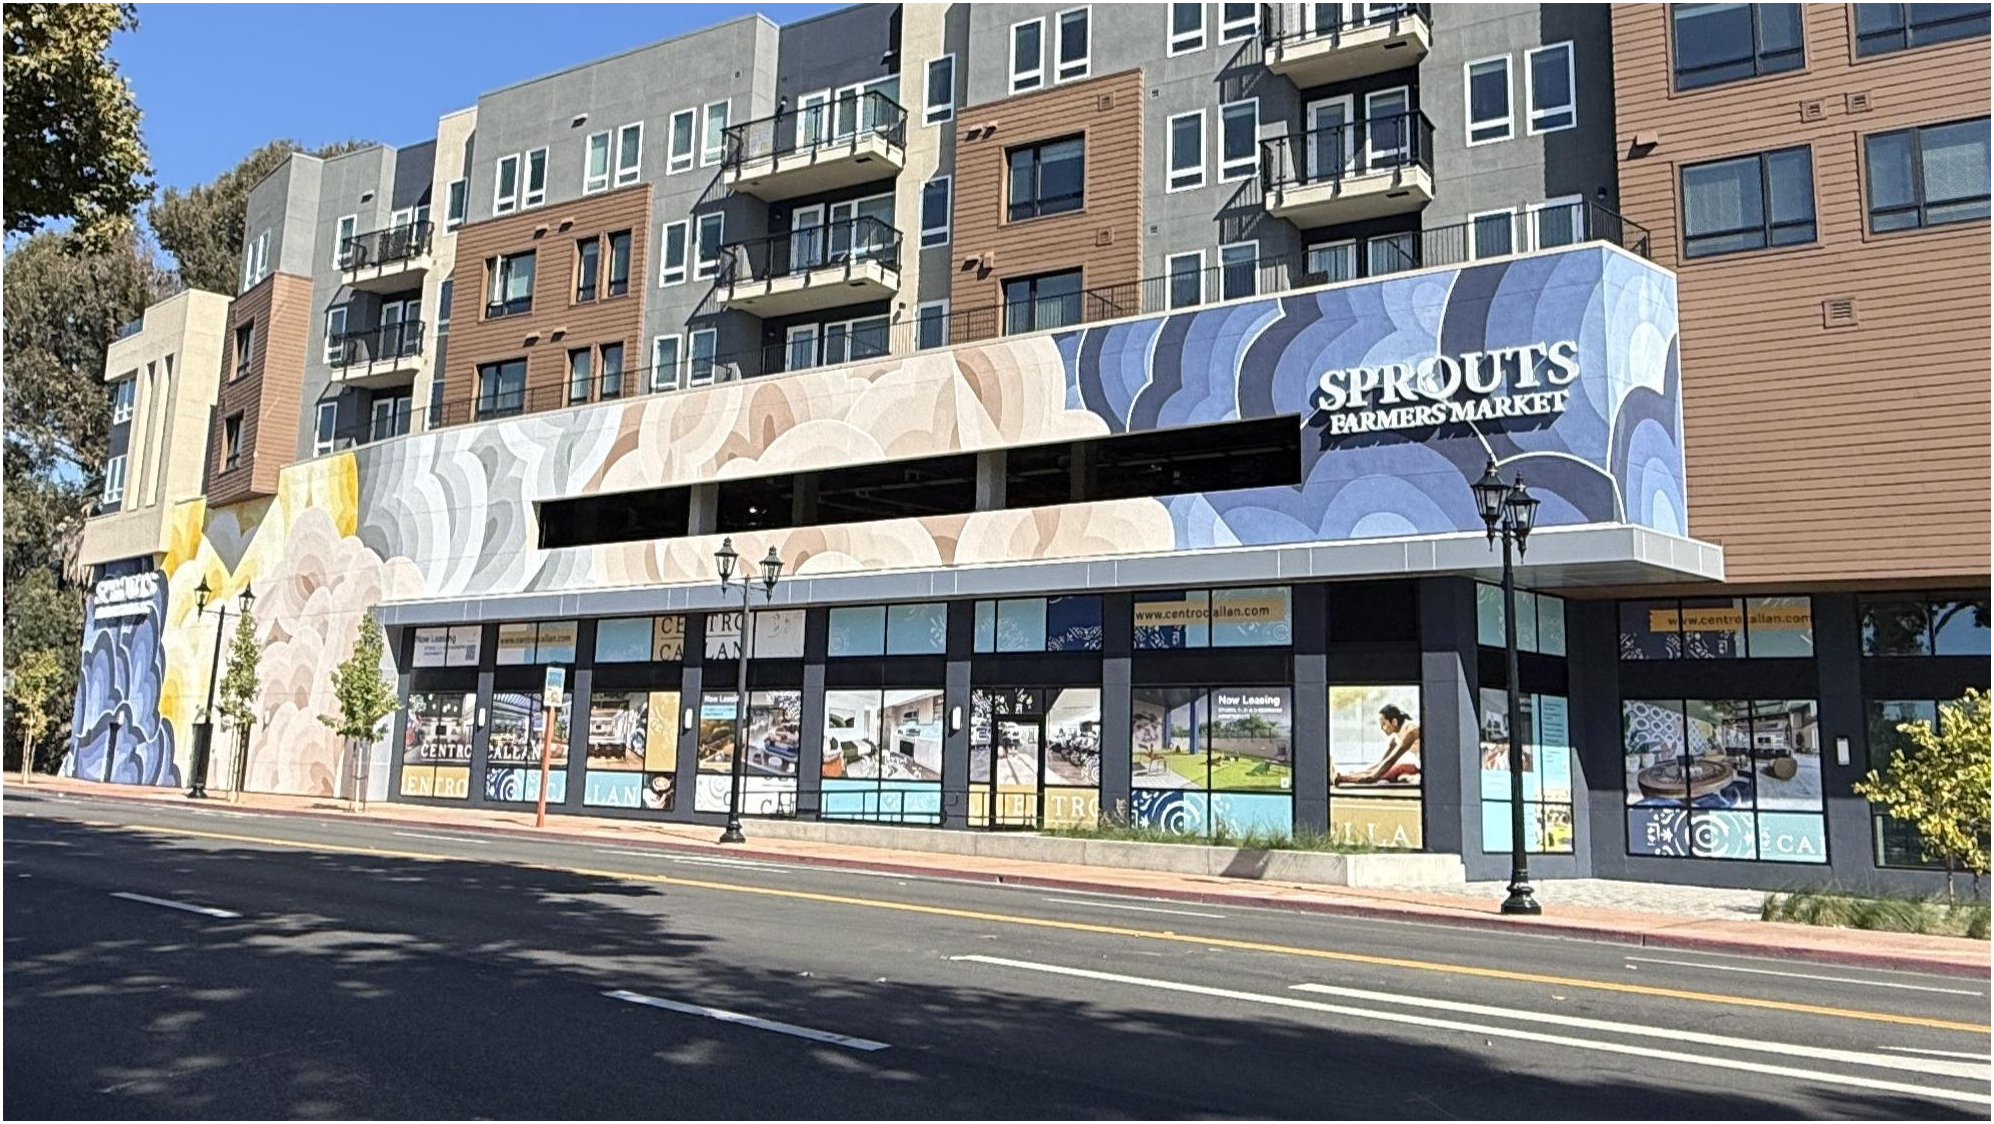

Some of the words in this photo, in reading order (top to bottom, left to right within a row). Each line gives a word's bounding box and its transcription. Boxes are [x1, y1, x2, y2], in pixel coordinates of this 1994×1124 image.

[1318, 339, 1581, 412] SPROUTS
[1329, 404, 1447, 436] FARMERS
[1450, 389, 1571, 423] MARKET
[1668, 612, 1809, 626] www.centroallan.com
[430, 634, 457, 645] Leasng
[500, 634, 571, 644] www.centroallan.com
[1218, 695, 1239, 705] Now
[1242, 694, 1281, 707] Leasing
